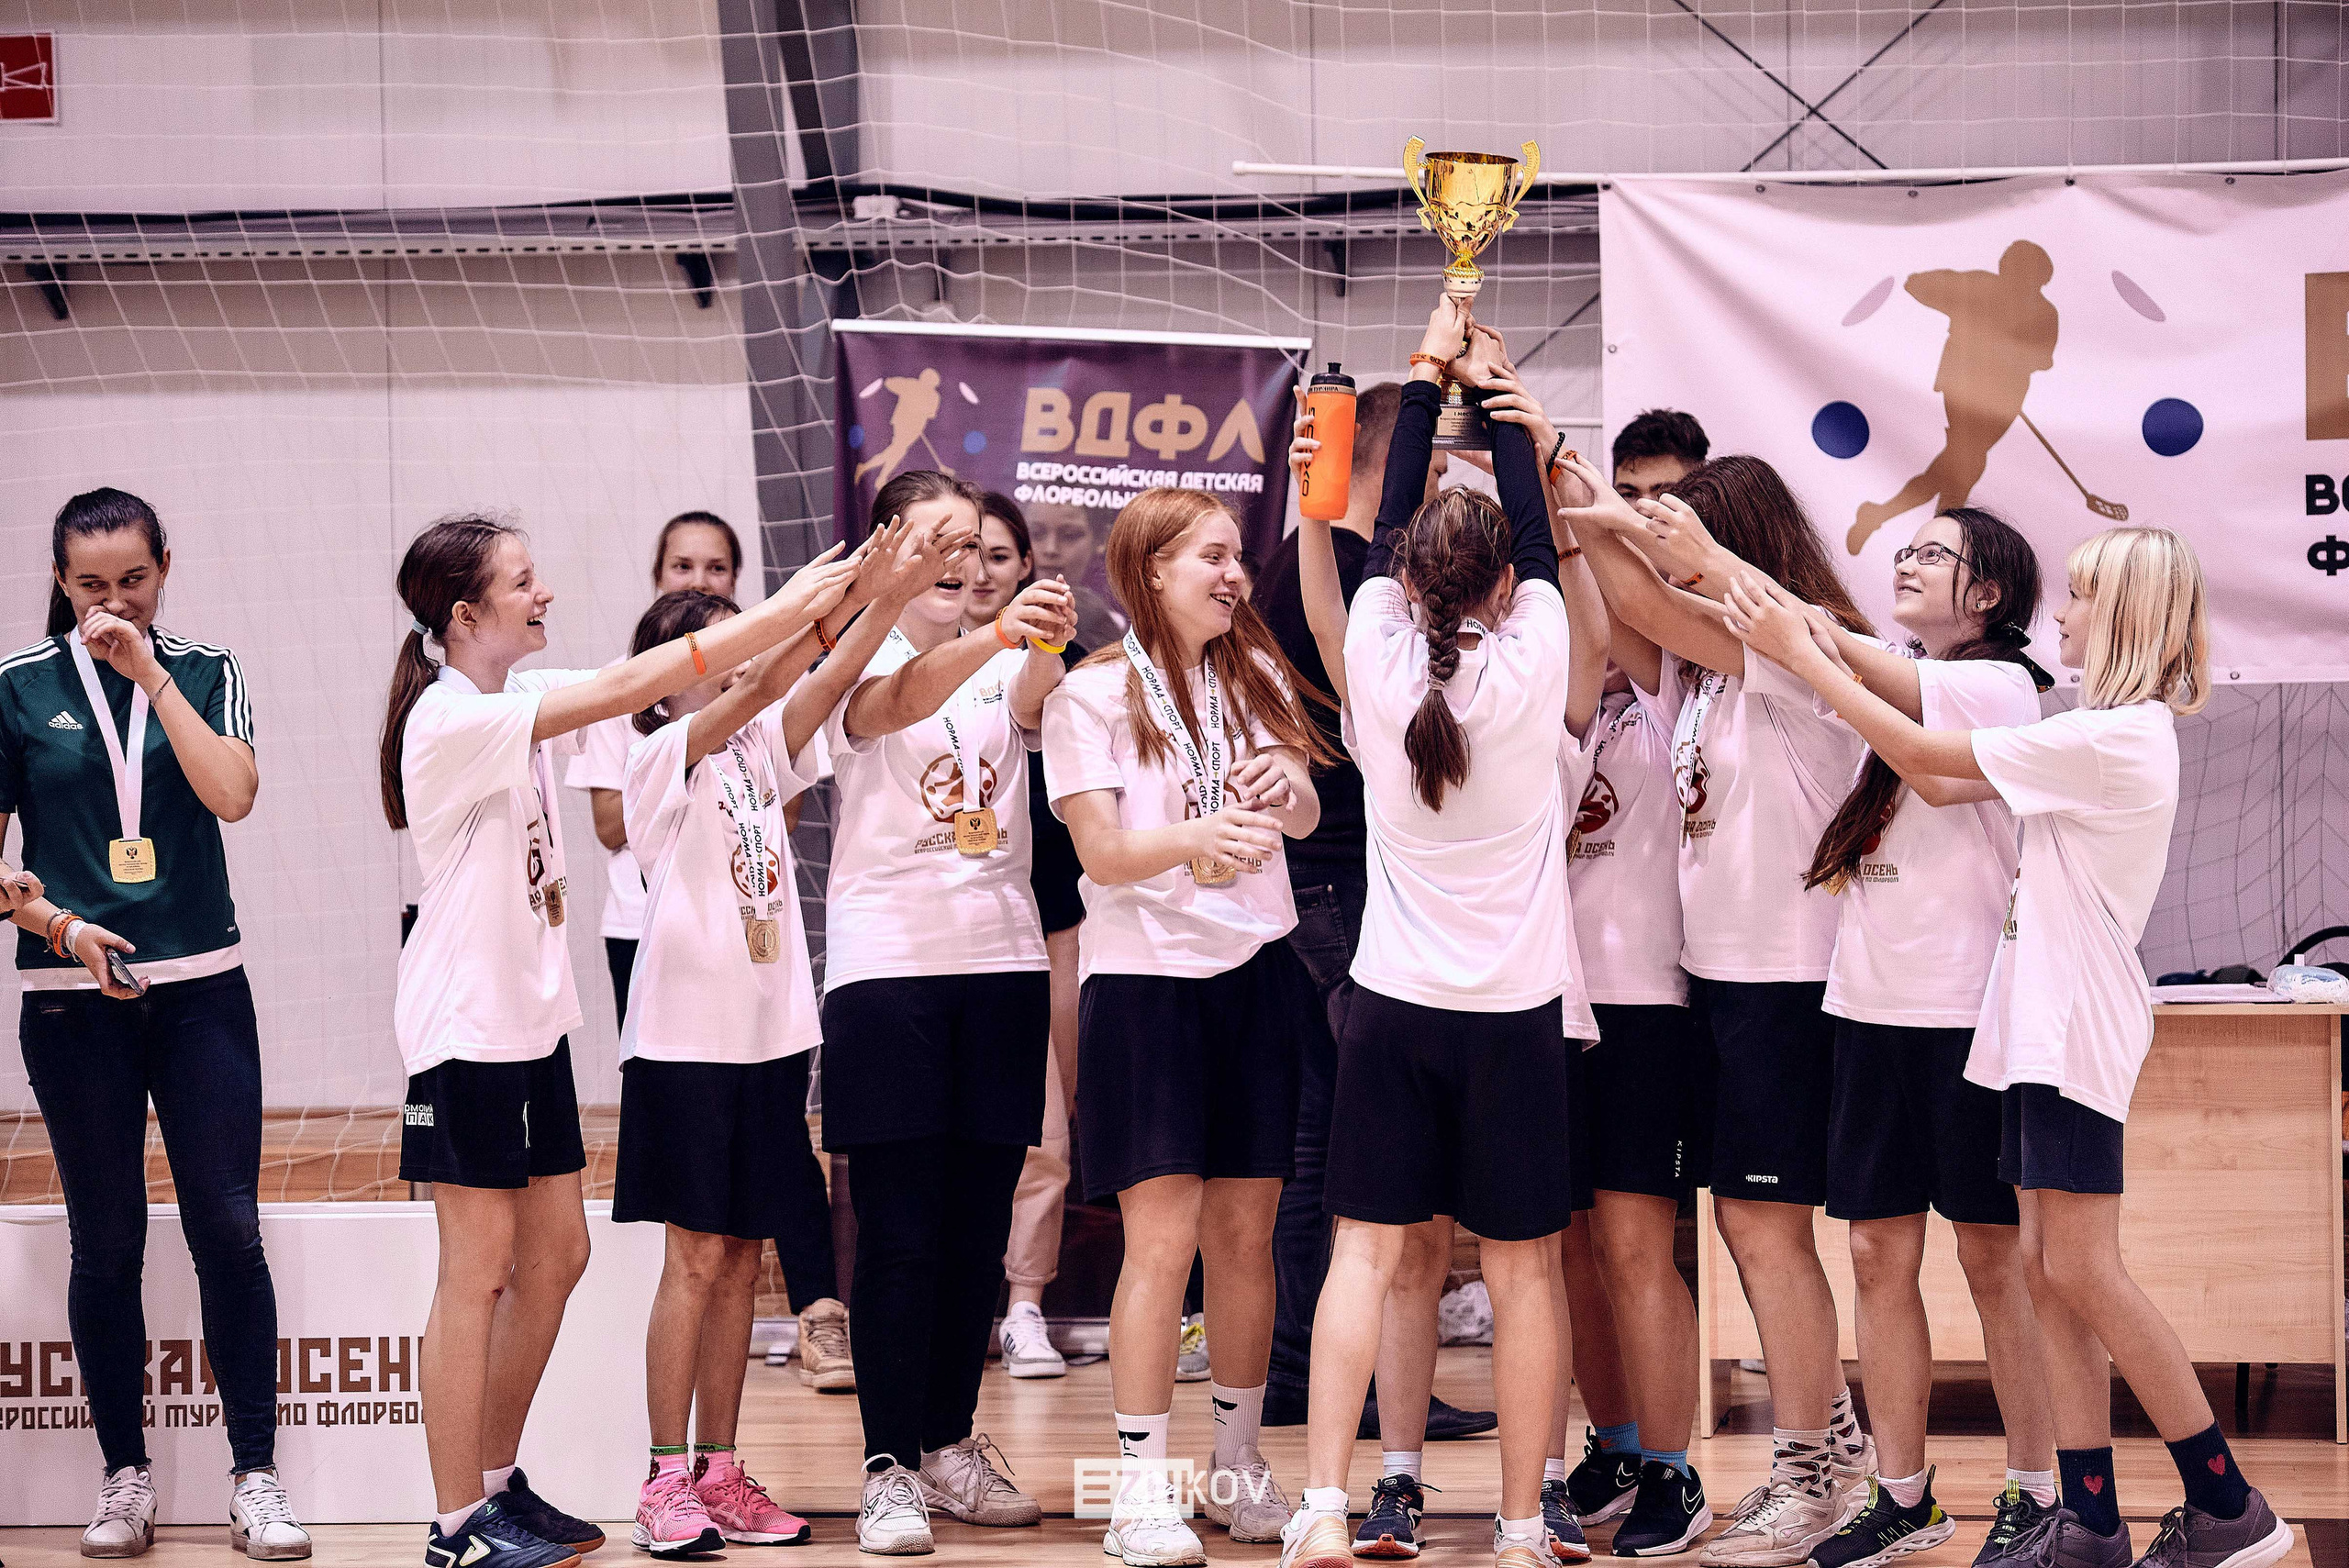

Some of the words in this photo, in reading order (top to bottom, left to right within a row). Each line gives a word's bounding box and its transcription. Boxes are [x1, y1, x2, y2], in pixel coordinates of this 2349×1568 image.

[1019, 386, 1265, 464] ВДФЛ
[1302, 407, 1315, 496] OXOG
[1016, 462, 1178, 489] ВСЕРОССИЙСКАЯ
[1179, 471, 1265, 494] ДЕТСКАЯ
[2306, 474, 2349, 516] В
[1141, 666, 1164, 698] НОРМА
[1163, 705, 1183, 731] СПОРТ
[1209, 695, 1219, 728] НОРМА
[48, 721, 83, 730] adidas
[942, 717, 961, 750] НОРМА
[1212, 741, 1220, 771] СПОРТ
[1184, 742, 1203, 778] НОРМА
[1199, 785, 1208, 814] СПО
[723, 783, 739, 809] СПОРТ
[743, 779, 759, 812] НОРМА
[739, 822, 752, 858] НОРМА
[753, 825, 763, 853] СПОРТ
[757, 862, 766, 896] НОРМА
[1864, 863, 1898, 876] ОСЕНЬ
[277, 1336, 424, 1393] СЕН
[166, 1404, 227, 1429] ТУР
[277, 1403, 306, 1427] ПО
[317, 1400, 425, 1428] ФЛОРБО
